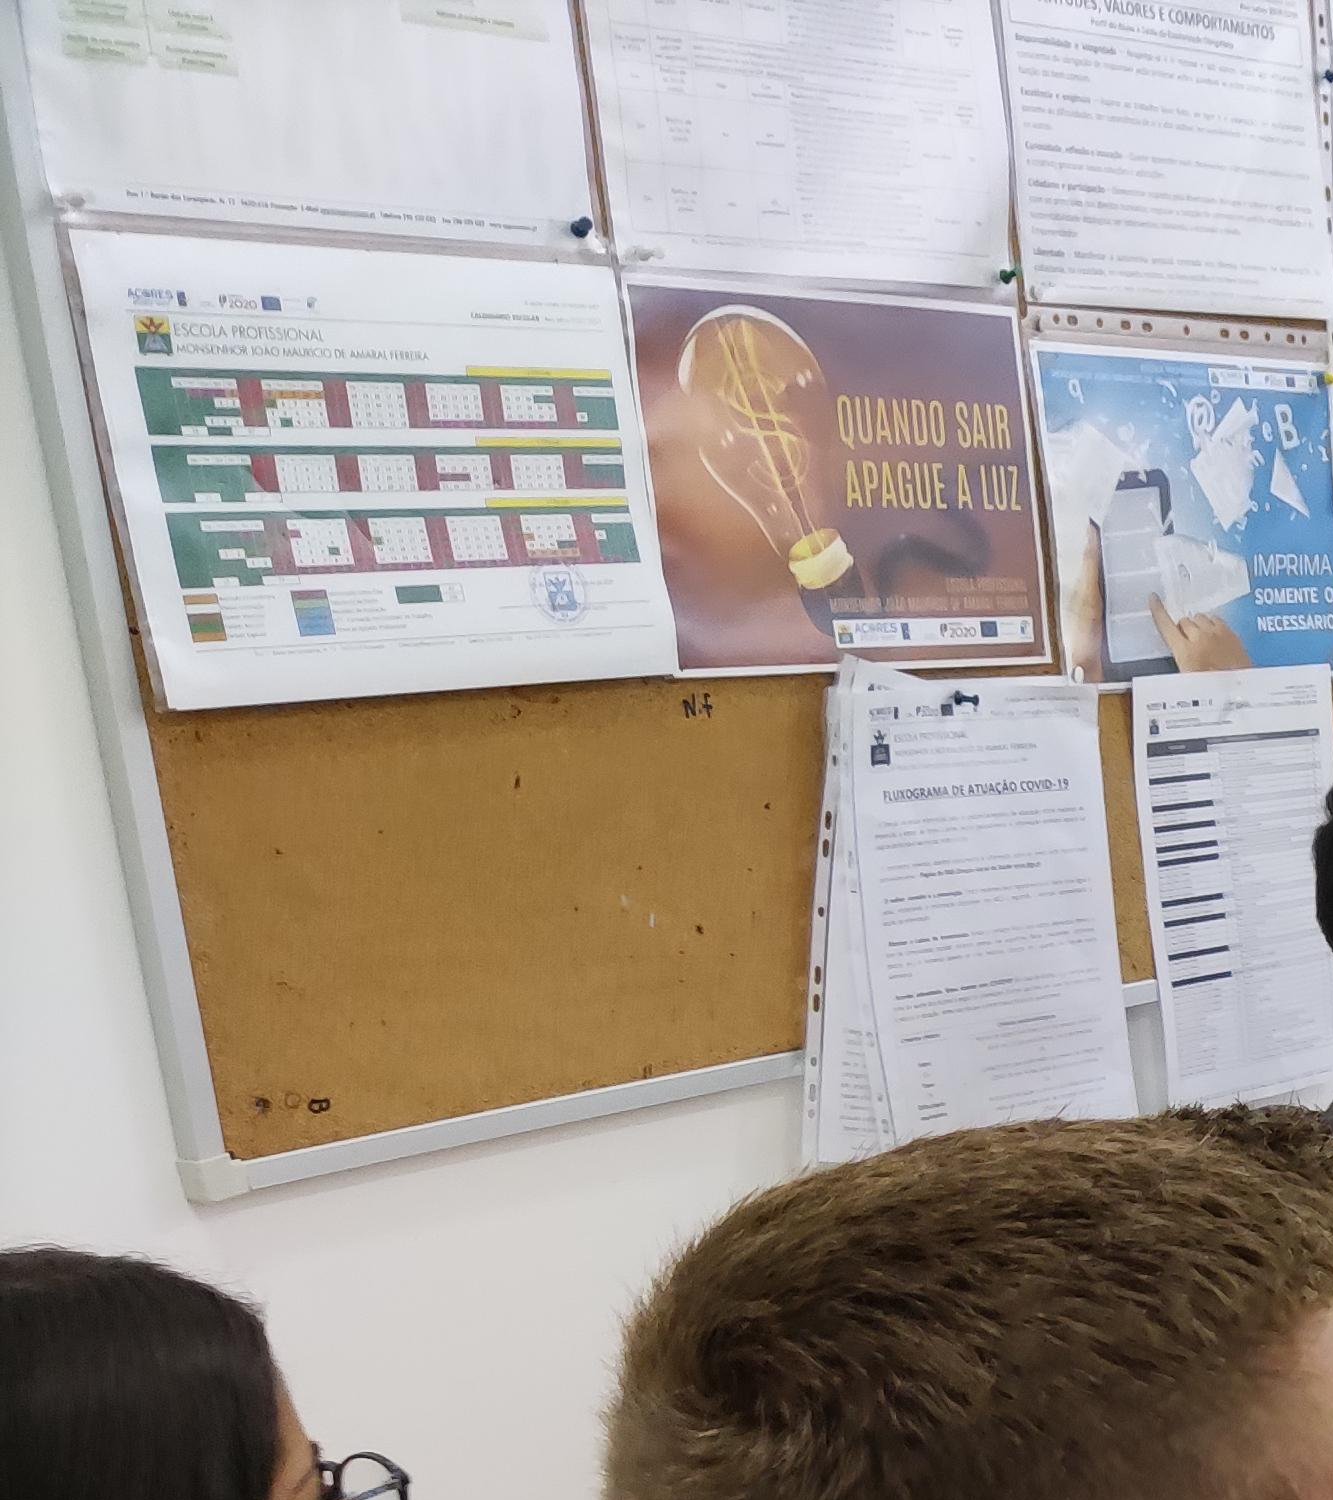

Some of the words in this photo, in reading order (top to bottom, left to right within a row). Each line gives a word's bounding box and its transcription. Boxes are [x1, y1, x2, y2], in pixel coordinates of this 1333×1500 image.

[1105, 0, 1155, 20] VALORES
[1159, 6, 1165, 22] E
[1168, 10, 1275, 41] COMPORTAMENTOS
[173, 322, 228, 339] ESCOLA
[231, 325, 324, 342] PROFISSIONAL
[837, 394, 946, 450] QUANDO
[955, 401, 1011, 449] SAIR
[846, 459, 948, 510] APAGUE
[958, 463, 973, 510] A
[979, 464, 1021, 511] LUZ
[1253, 553, 1333, 577] IMPRIMA
[1254, 587, 1319, 605] SOMENTE
[883, 785, 948, 802] FLUXOGRAMA
[952, 785, 965, 797] DE
[968, 779, 1017, 796] ATUAÇÃO
[1020, 778, 1069, 792] COVID-19
